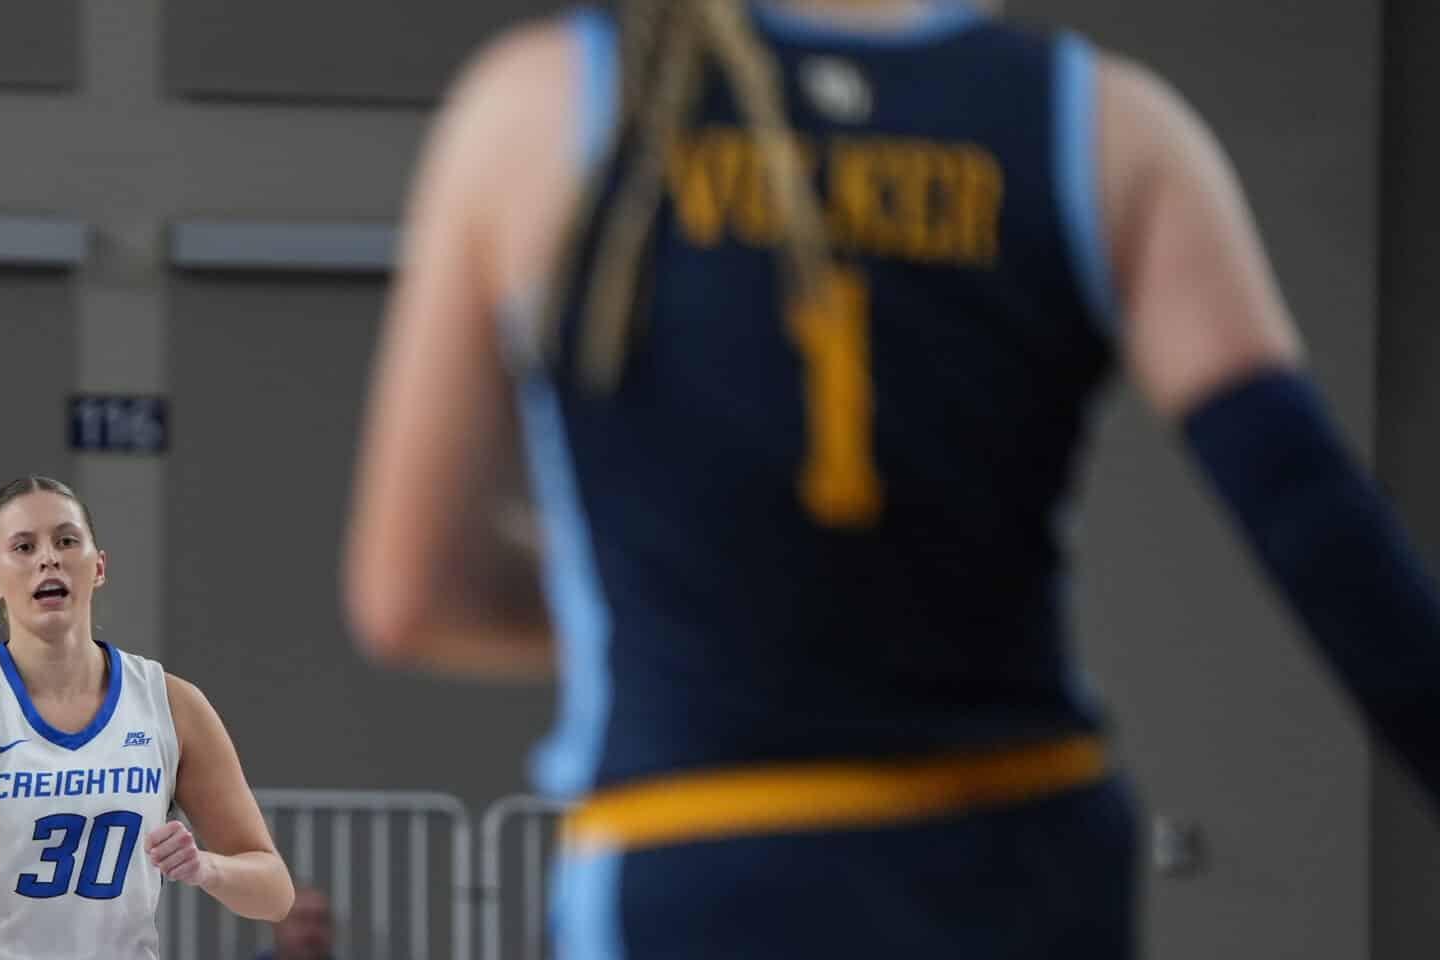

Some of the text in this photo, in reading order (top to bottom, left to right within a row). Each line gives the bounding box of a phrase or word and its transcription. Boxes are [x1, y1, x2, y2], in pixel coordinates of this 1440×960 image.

[783, 266, 882, 527] 1
[124, 737, 152, 746] EAST
[126, 731, 145, 739] BIG
[15, 810, 143, 900] 30
